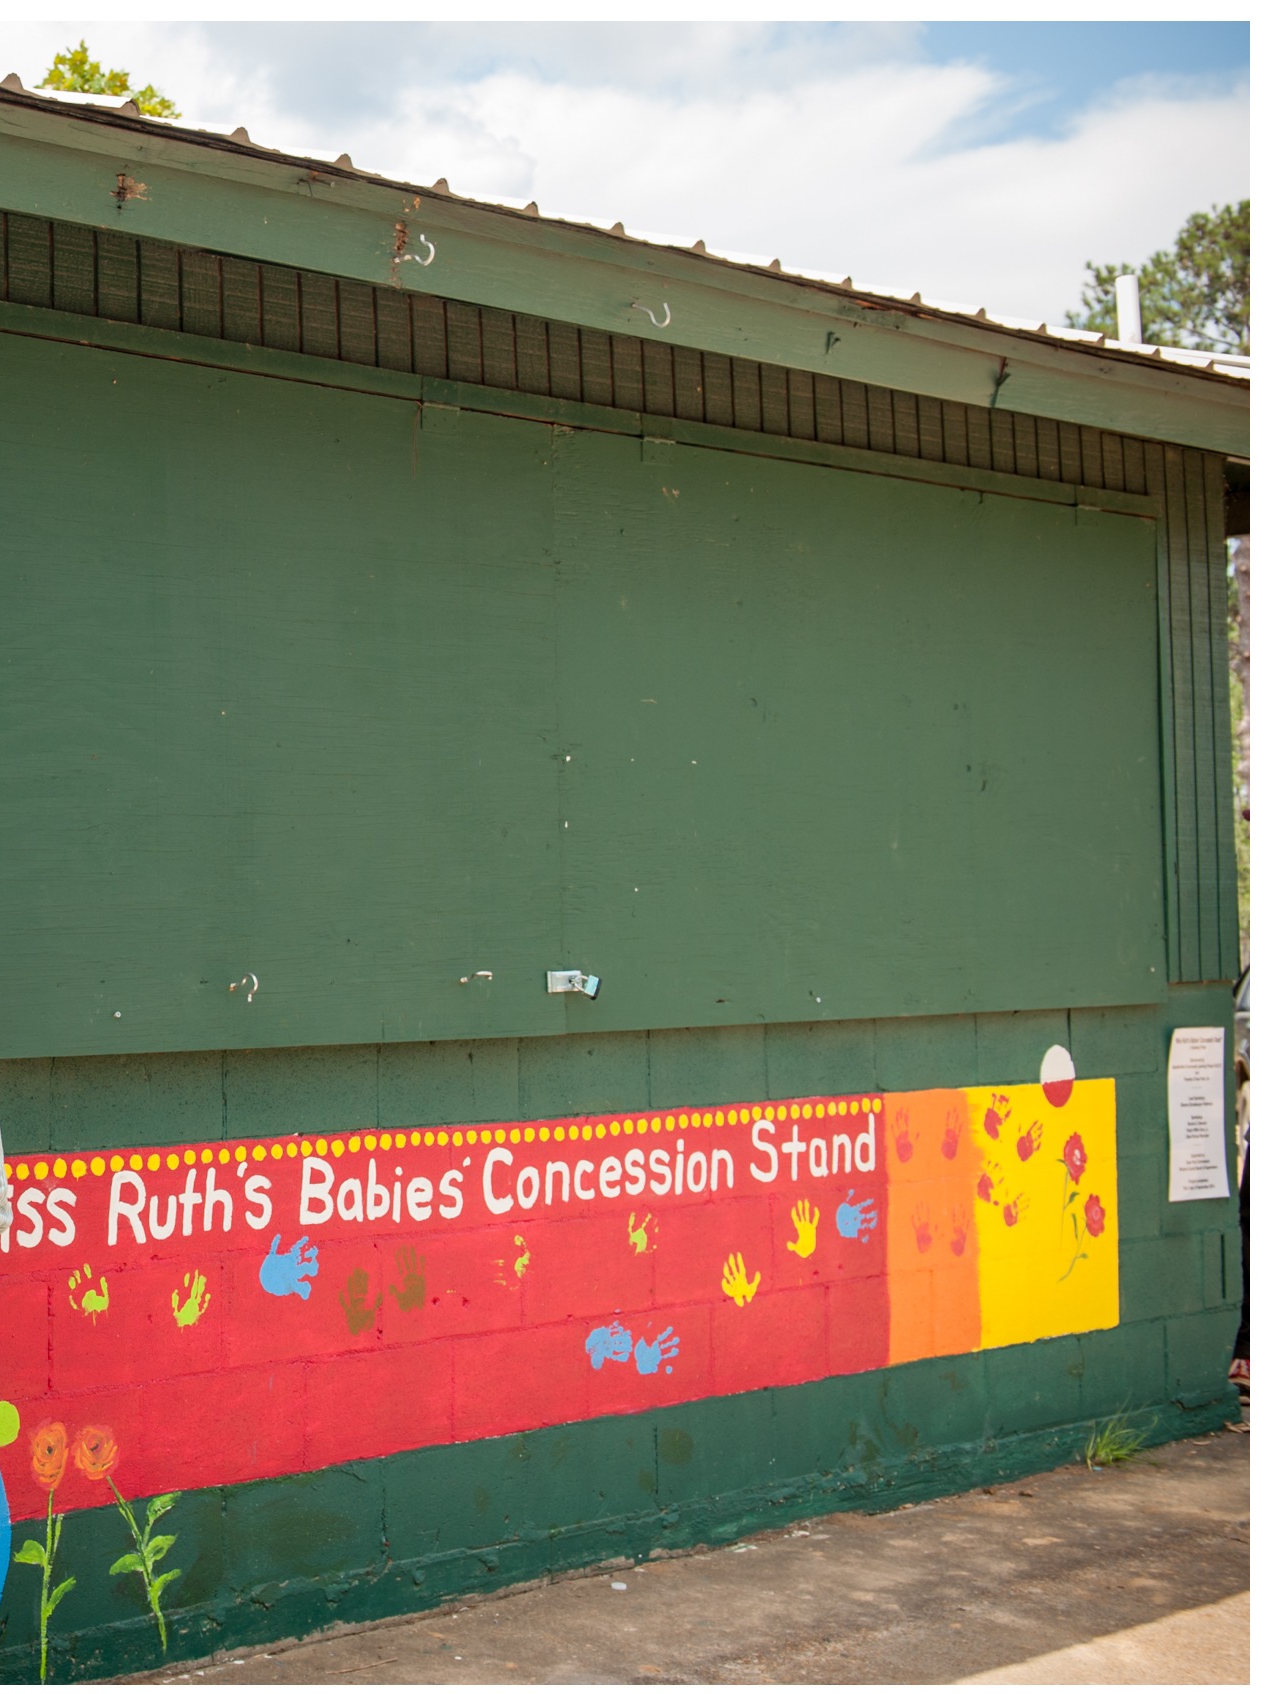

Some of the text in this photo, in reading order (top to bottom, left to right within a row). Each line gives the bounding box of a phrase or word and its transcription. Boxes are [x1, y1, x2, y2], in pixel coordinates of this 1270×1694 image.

[108, 1160, 273, 1245] Ruth's
[300, 1154, 470, 1224] Babies'
[483, 1144, 733, 1216] Concession
[749, 1113, 876, 1183] Stand
